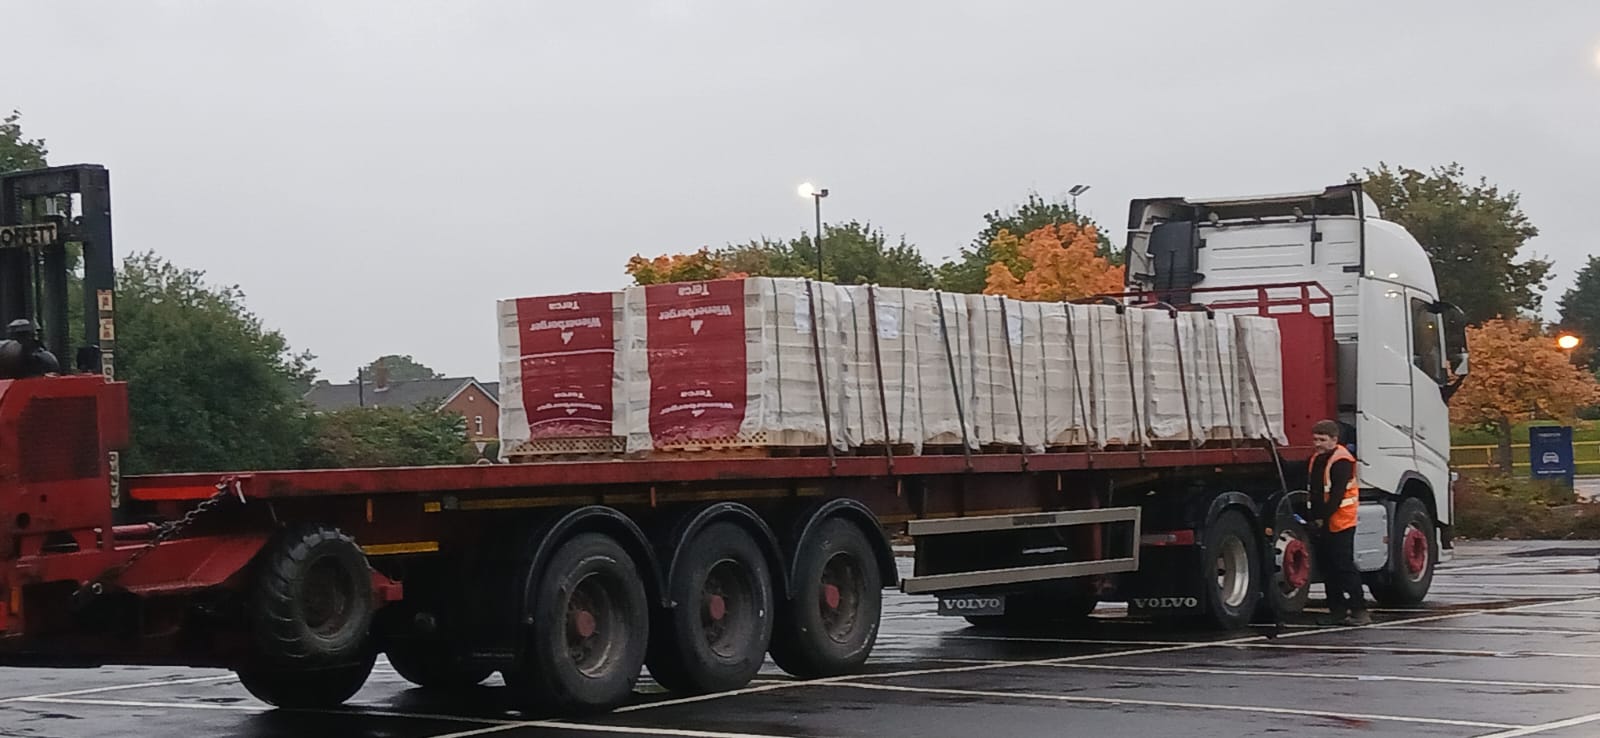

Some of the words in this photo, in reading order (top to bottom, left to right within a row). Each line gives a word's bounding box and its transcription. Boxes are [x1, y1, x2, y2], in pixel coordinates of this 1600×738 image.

[678, 283, 709, 295] Terca
[549, 301, 580, 310] Terca
[659, 305, 732, 320] Wienerberger
[529, 317, 602, 332] Wienerberger
[943, 598, 1000, 609] VOLVO
[1134, 597, 1198, 608] VOLVO
